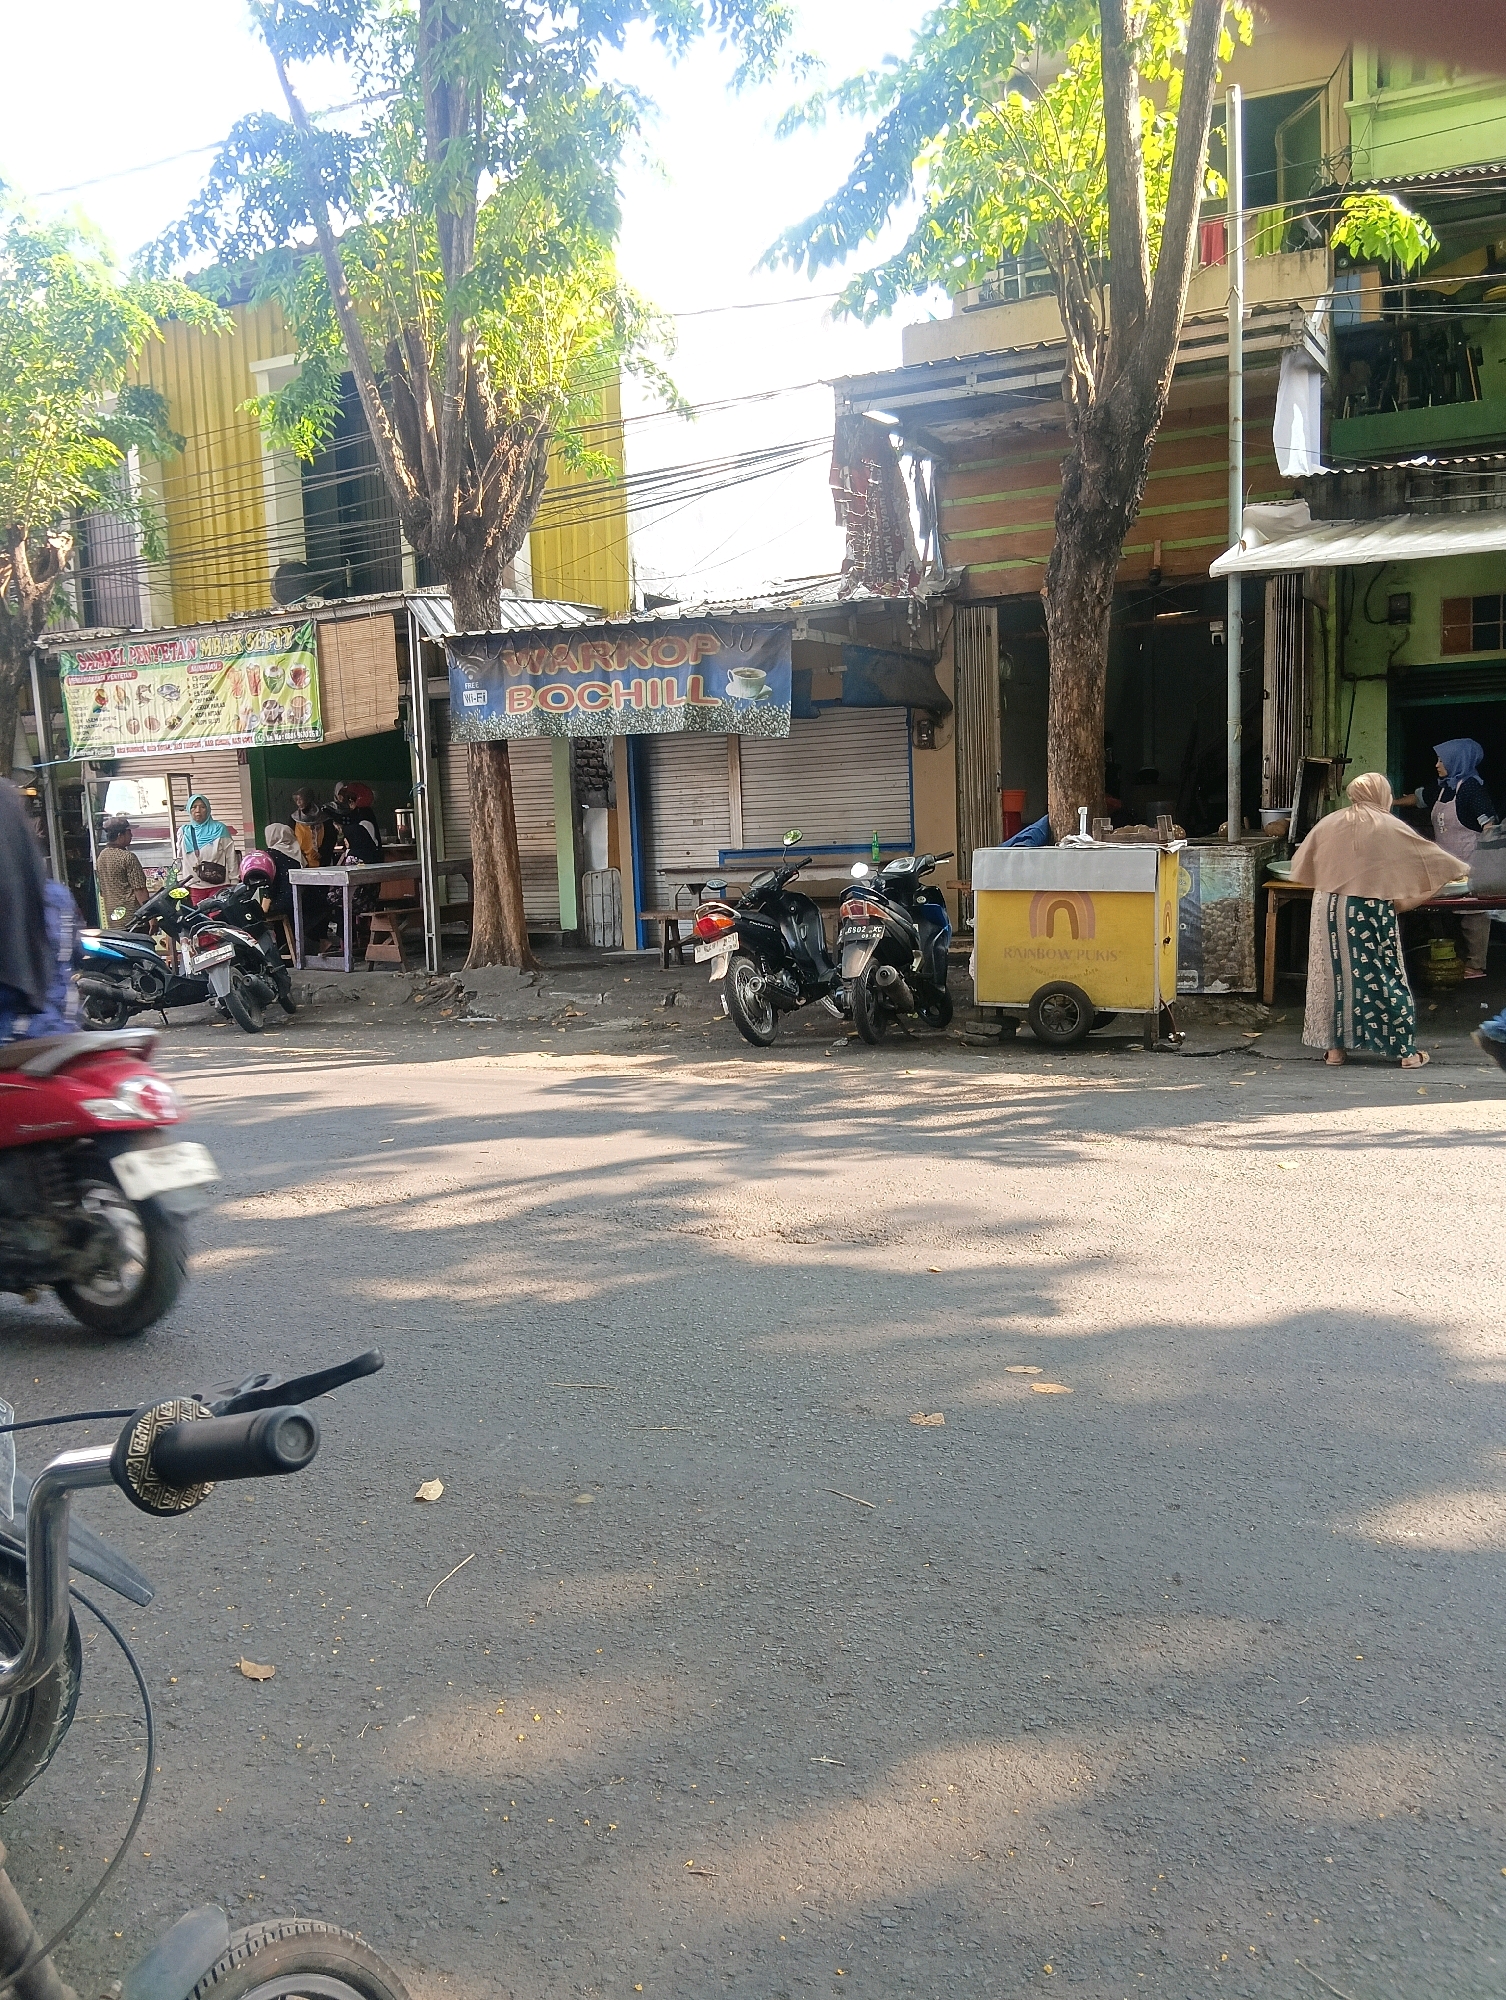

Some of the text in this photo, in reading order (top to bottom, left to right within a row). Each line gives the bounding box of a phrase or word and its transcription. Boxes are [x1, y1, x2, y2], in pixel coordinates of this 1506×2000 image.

[883, 535, 895, 573] HITAM
[76, 625, 295, 672] SAMBEL PENYETAN MBAK SEPTY
[502, 633, 721, 677] WARKOP
[464, 692, 486, 703] Wi-Fi
[506, 675, 722, 715] BOCHILL
[1004, 947, 1118, 962] RAINBOW PUKIS
